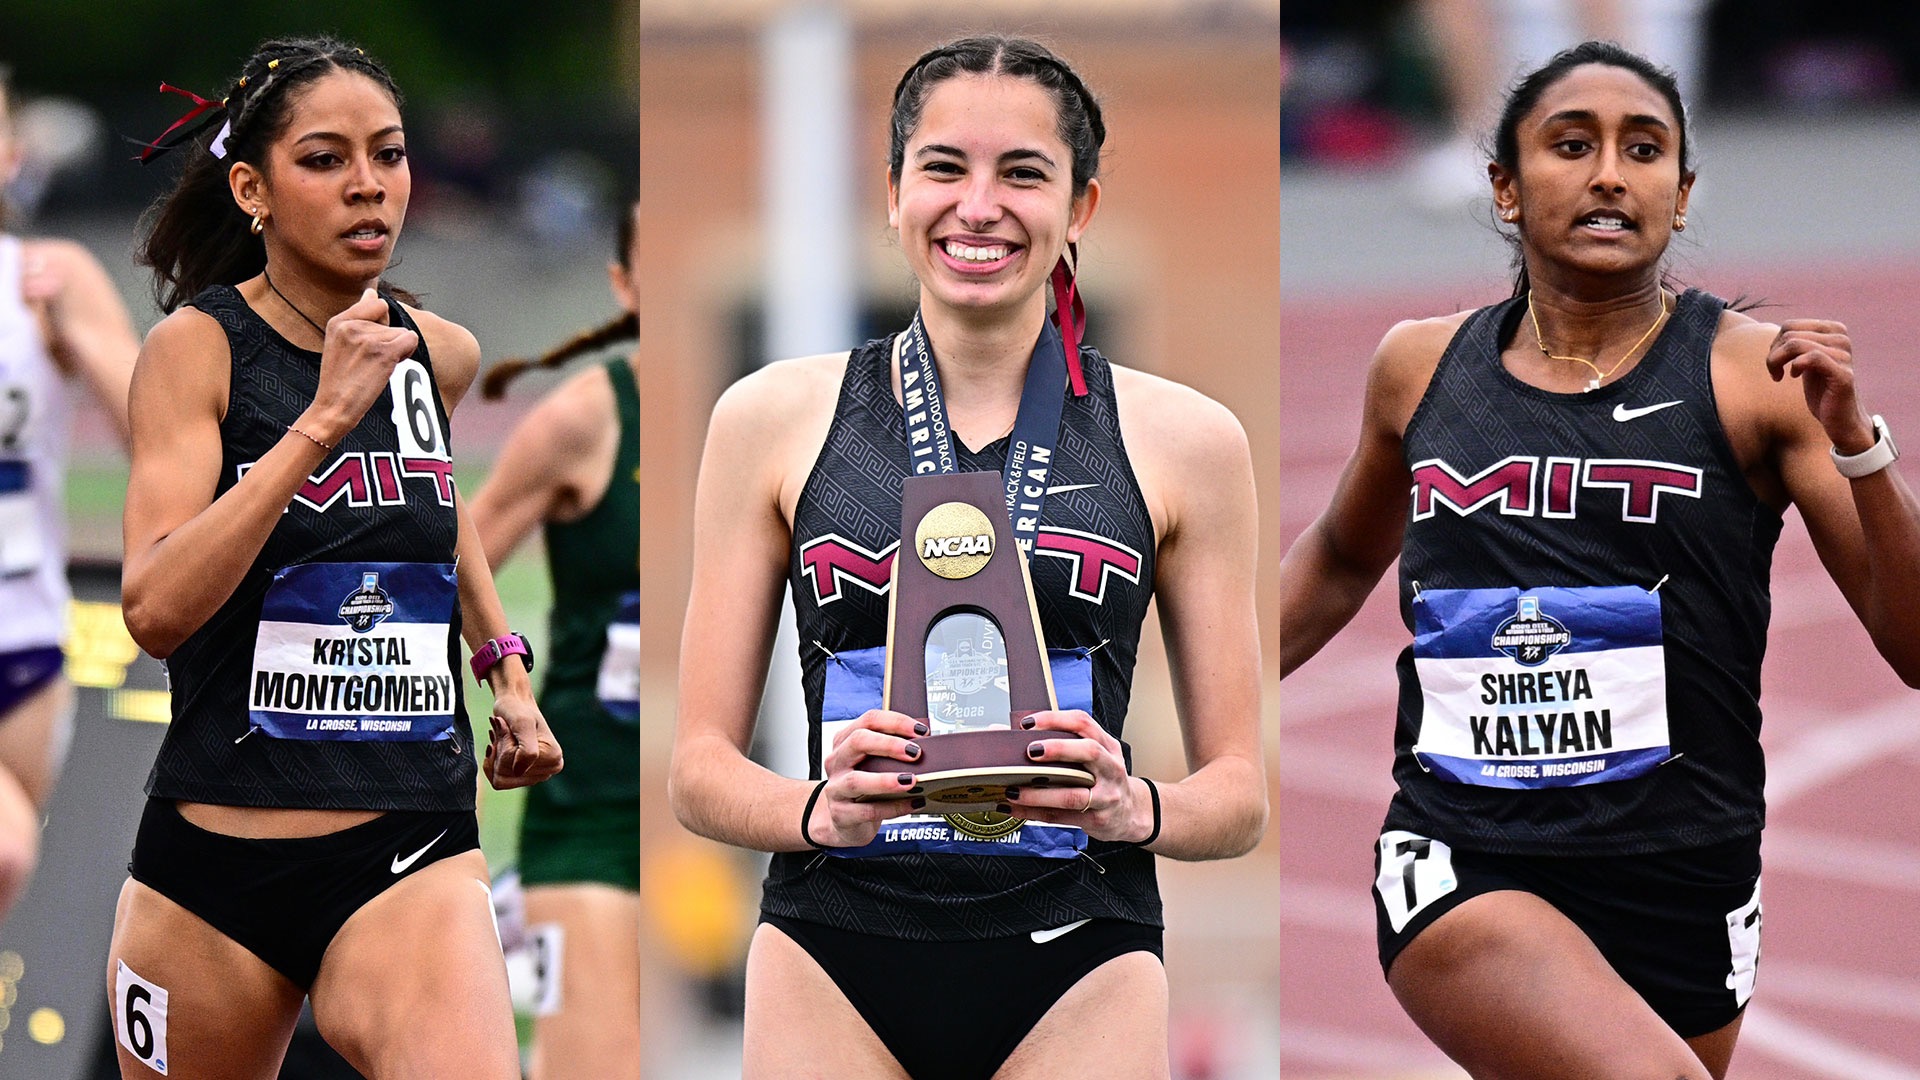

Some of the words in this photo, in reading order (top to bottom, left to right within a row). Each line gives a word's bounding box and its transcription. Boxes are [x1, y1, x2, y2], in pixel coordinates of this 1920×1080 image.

[404, 368, 436, 453] 6
[926, 381, 946, 439] OUTDOOR
[937, 436, 953, 474] TRACK
[1012, 441, 1027, 471] FIELD
[1010, 470, 1022, 478] &
[1410, 456, 1703, 524] MIT
[1006, 479, 1021, 513] TRACK
[1014, 445, 1051, 554] ERICAN
[923, 535, 992, 558] NCAA
[800, 526, 1142, 605] MT
[313, 637, 411, 666] KRYSTAL
[1494, 633, 1568, 646] CHAMPIONSHIPS
[253, 670, 450, 712] MONTGOMERY
[1481, 669, 1593, 705] SHREYA
[306, 719, 318, 730] LA
[319, 720, 358, 732] CROSSE,
[360, 720, 412, 732] WISCONSIN
[956, 705, 985, 717] 2026
[1469, 709, 1613, 756] KALYAN
[1481, 765, 1496, 777] LA
[1496, 765, 1540, 779] CROSSE,
[1541, 759, 1605, 777] WISCONSIN
[885, 829, 898, 842] LA
[901, 828, 950, 842] CROSSE,
[953, 830, 1021, 844] WISIN
[1395, 839, 1431, 913] 7
[126, 983, 154, 1060] 6
